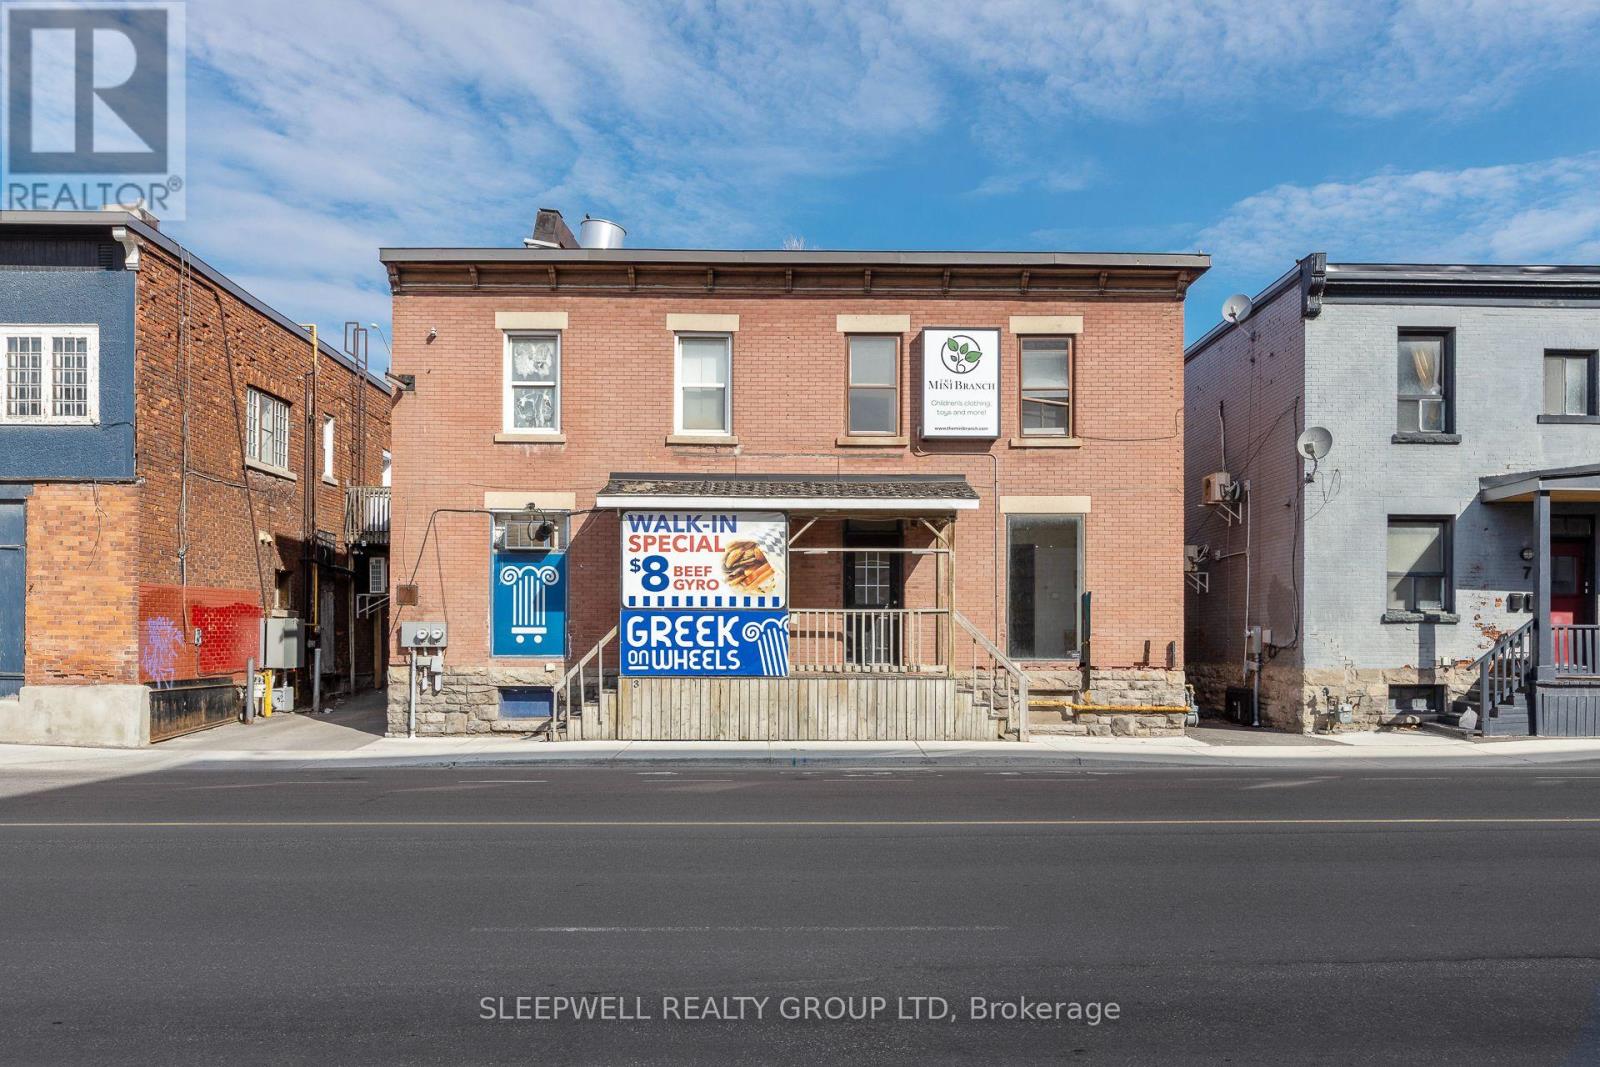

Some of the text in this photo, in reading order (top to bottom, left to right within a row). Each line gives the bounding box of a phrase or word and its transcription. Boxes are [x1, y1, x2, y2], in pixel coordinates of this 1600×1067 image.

[954, 380, 995, 390] BRANCH
[936, 409, 952, 417] toys
[627, 514, 737, 533] WALK-IN
[628, 535, 725, 553] SPECIAL
[673, 566, 713, 577] BEEF
[1522, 566, 1532, 580] 7
[673, 579, 719, 591] GYRO
[626, 615, 740, 648] GREEK
[651, 649, 741, 671] WHEELS
[633, 679, 640, 689] 3
